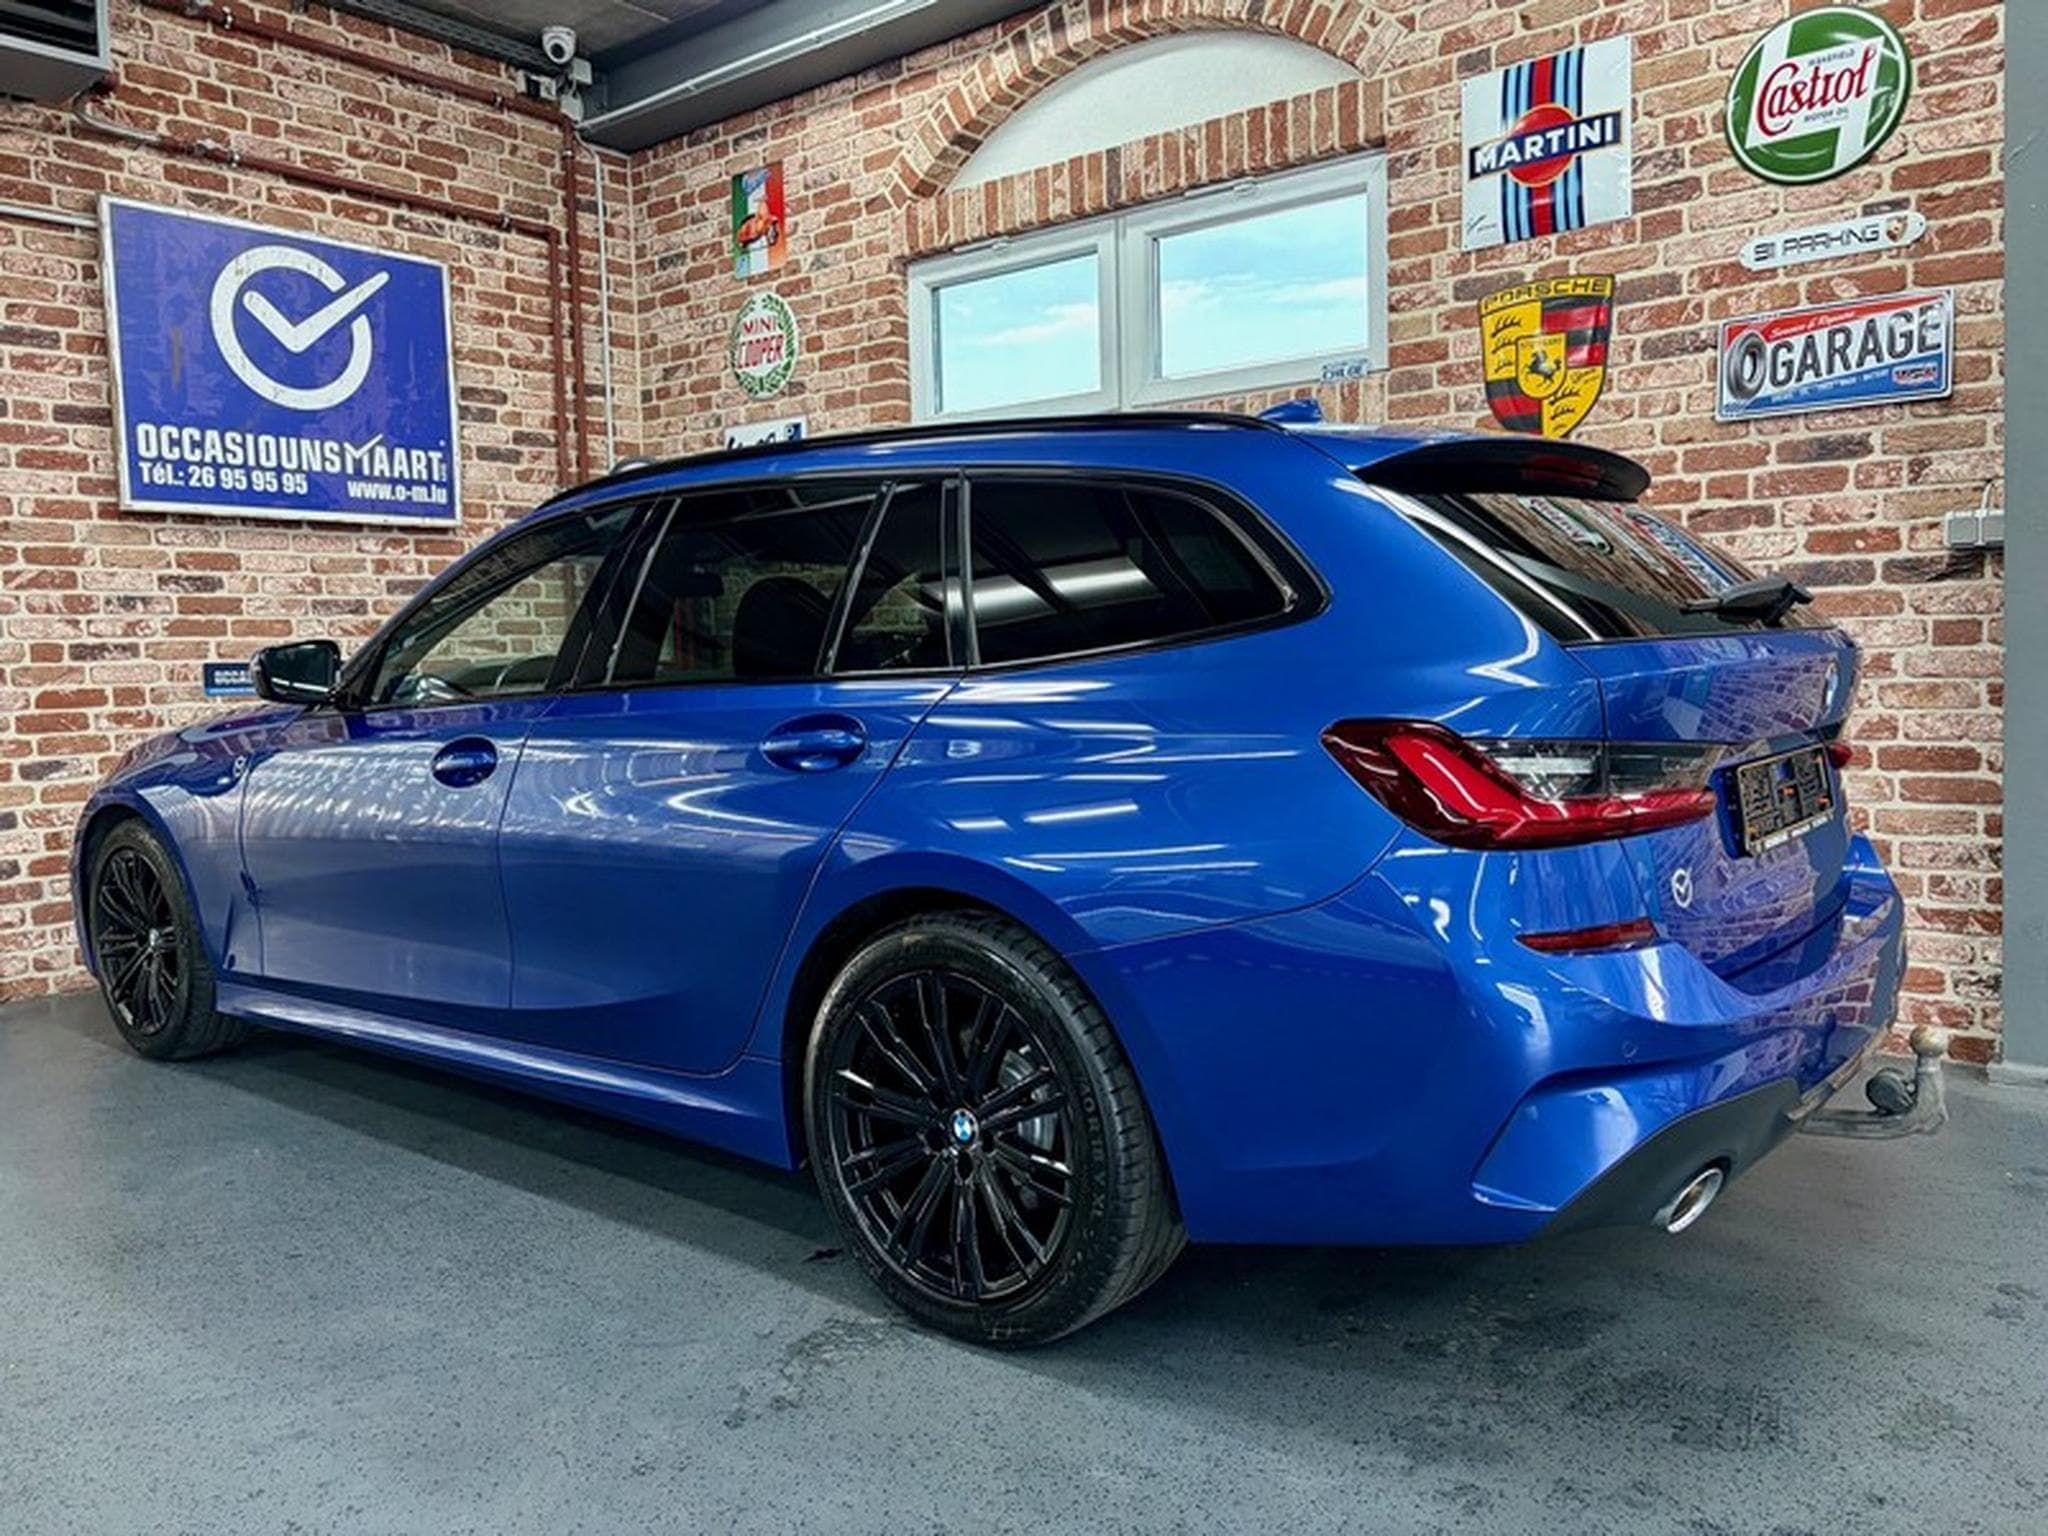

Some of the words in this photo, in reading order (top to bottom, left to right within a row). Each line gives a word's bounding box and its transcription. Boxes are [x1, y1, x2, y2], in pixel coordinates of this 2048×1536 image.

[1757, 45, 1877, 137] Castrol
[1475, 116, 1614, 174] MARTINI
[1781, 224, 1879, 256] PARKING
[1484, 279, 1606, 310] PORSCHE
[742, 315, 777, 336] MINI
[736, 334, 784, 369] COOPER
[1768, 301, 1944, 388] GARAGE
[188, 466, 216, 489] 26
[219, 468, 248, 491] 95
[251, 470, 278, 493] 95
[281, 473, 308, 495] 95
[347, 480, 447, 505] www.o-m.lu
